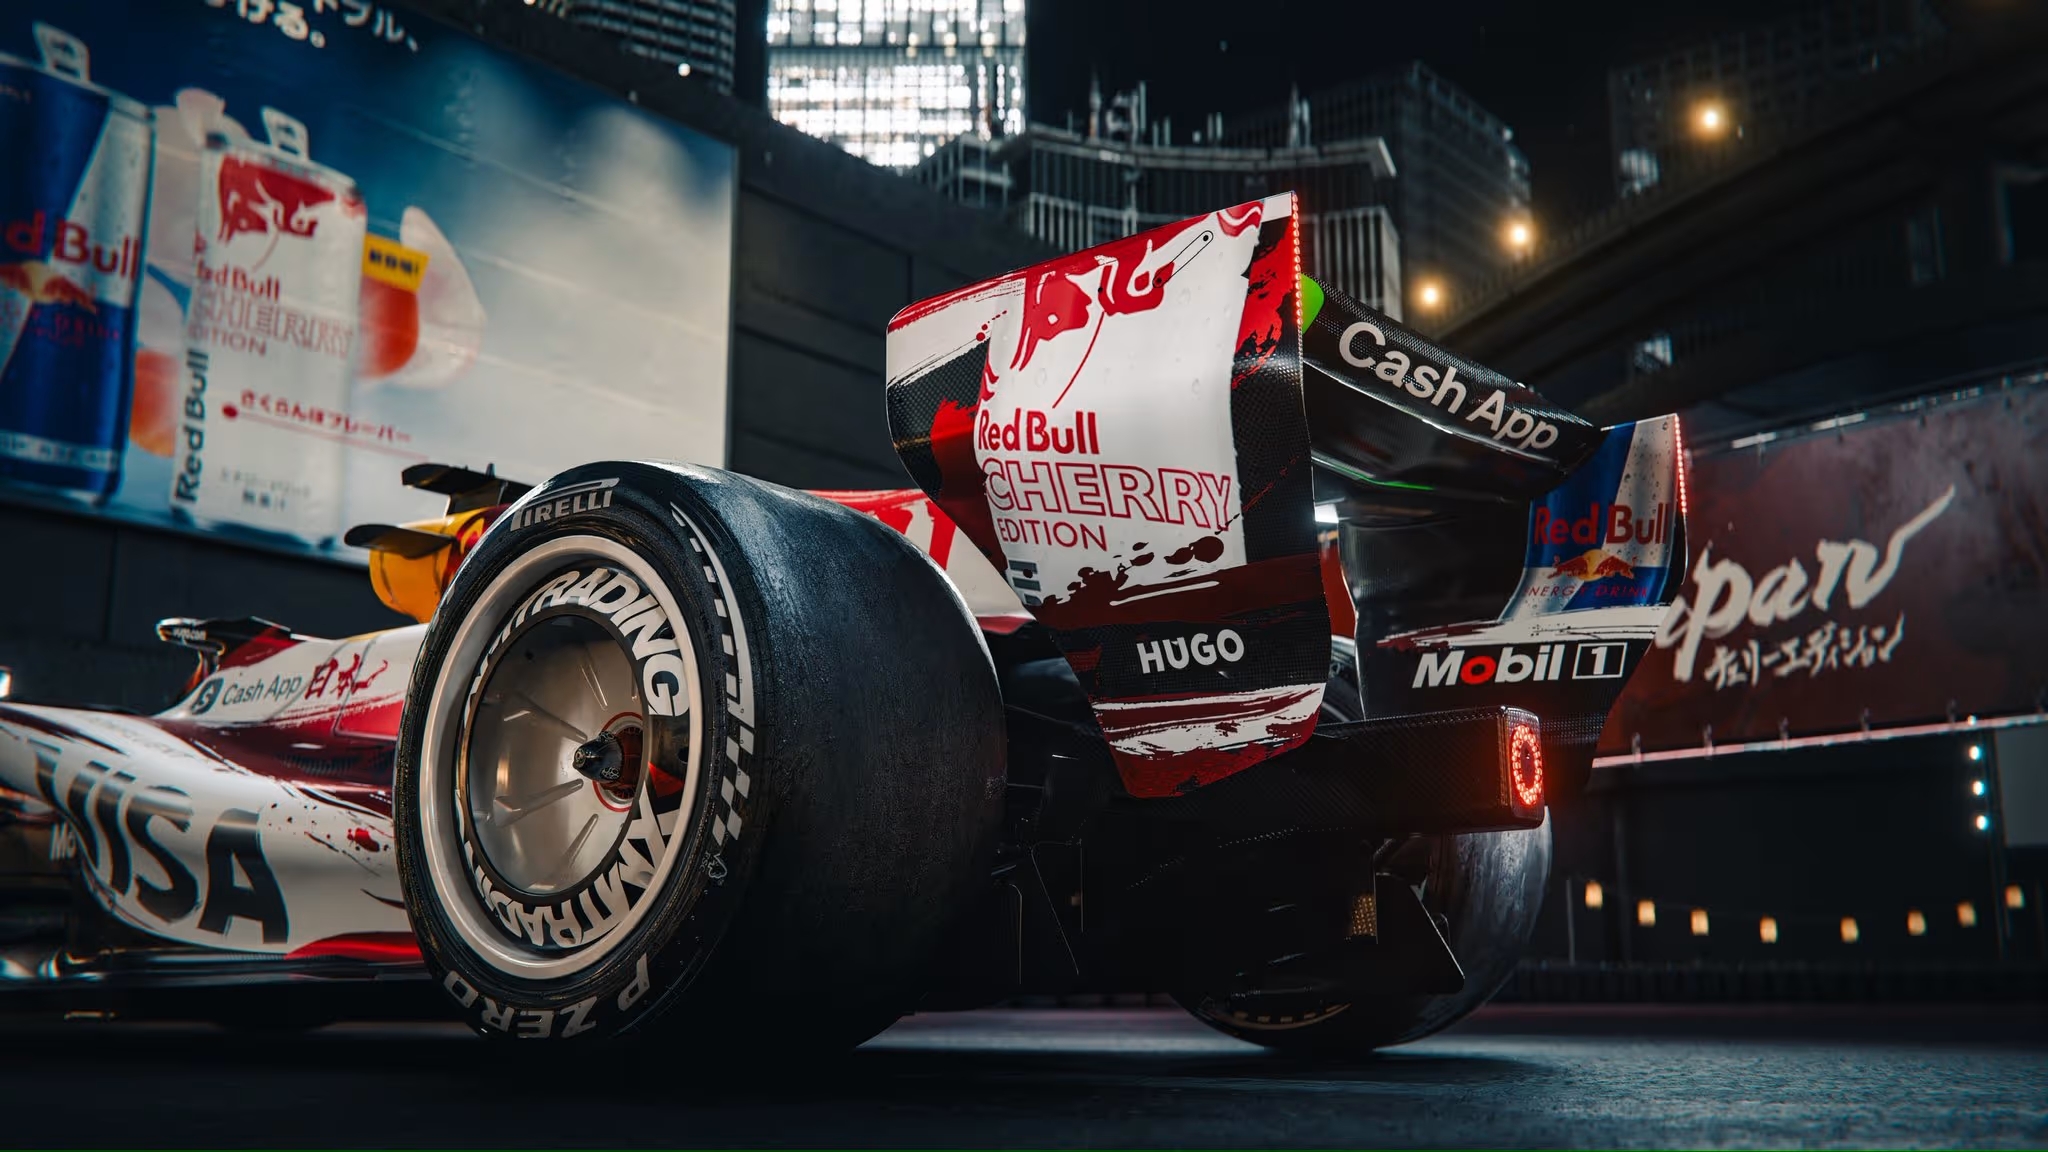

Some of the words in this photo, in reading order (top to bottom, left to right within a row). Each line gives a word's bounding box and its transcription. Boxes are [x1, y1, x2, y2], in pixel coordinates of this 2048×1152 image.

[54, 217, 139, 281] Bull
[232, 266, 280, 301] Bull
[184, 348, 210, 421] Bull
[1339, 321, 1468, 413] Cash
[1466, 389, 1559, 450] App
[978, 408, 1021, 453] Red
[1027, 410, 1098, 455] Bull
[175, 423, 206, 504] Red
[510, 477, 621, 532] PIRELLI
[982, 456, 1231, 532] CHERRY
[999, 516, 1108, 551] EDITION
[1534, 503, 1600, 545] Red
[1606, 503, 1669, 545] Bull
[1136, 629, 1246, 674] HUGO
[1412, 643, 1566, 689] Mobil
[222, 680, 265, 707] Cash
[264, 674, 303, 699] App
[27, 738, 290, 944] VISA
[442, 969, 599, 1040] ZERO
[617, 952, 651, 1012] P
